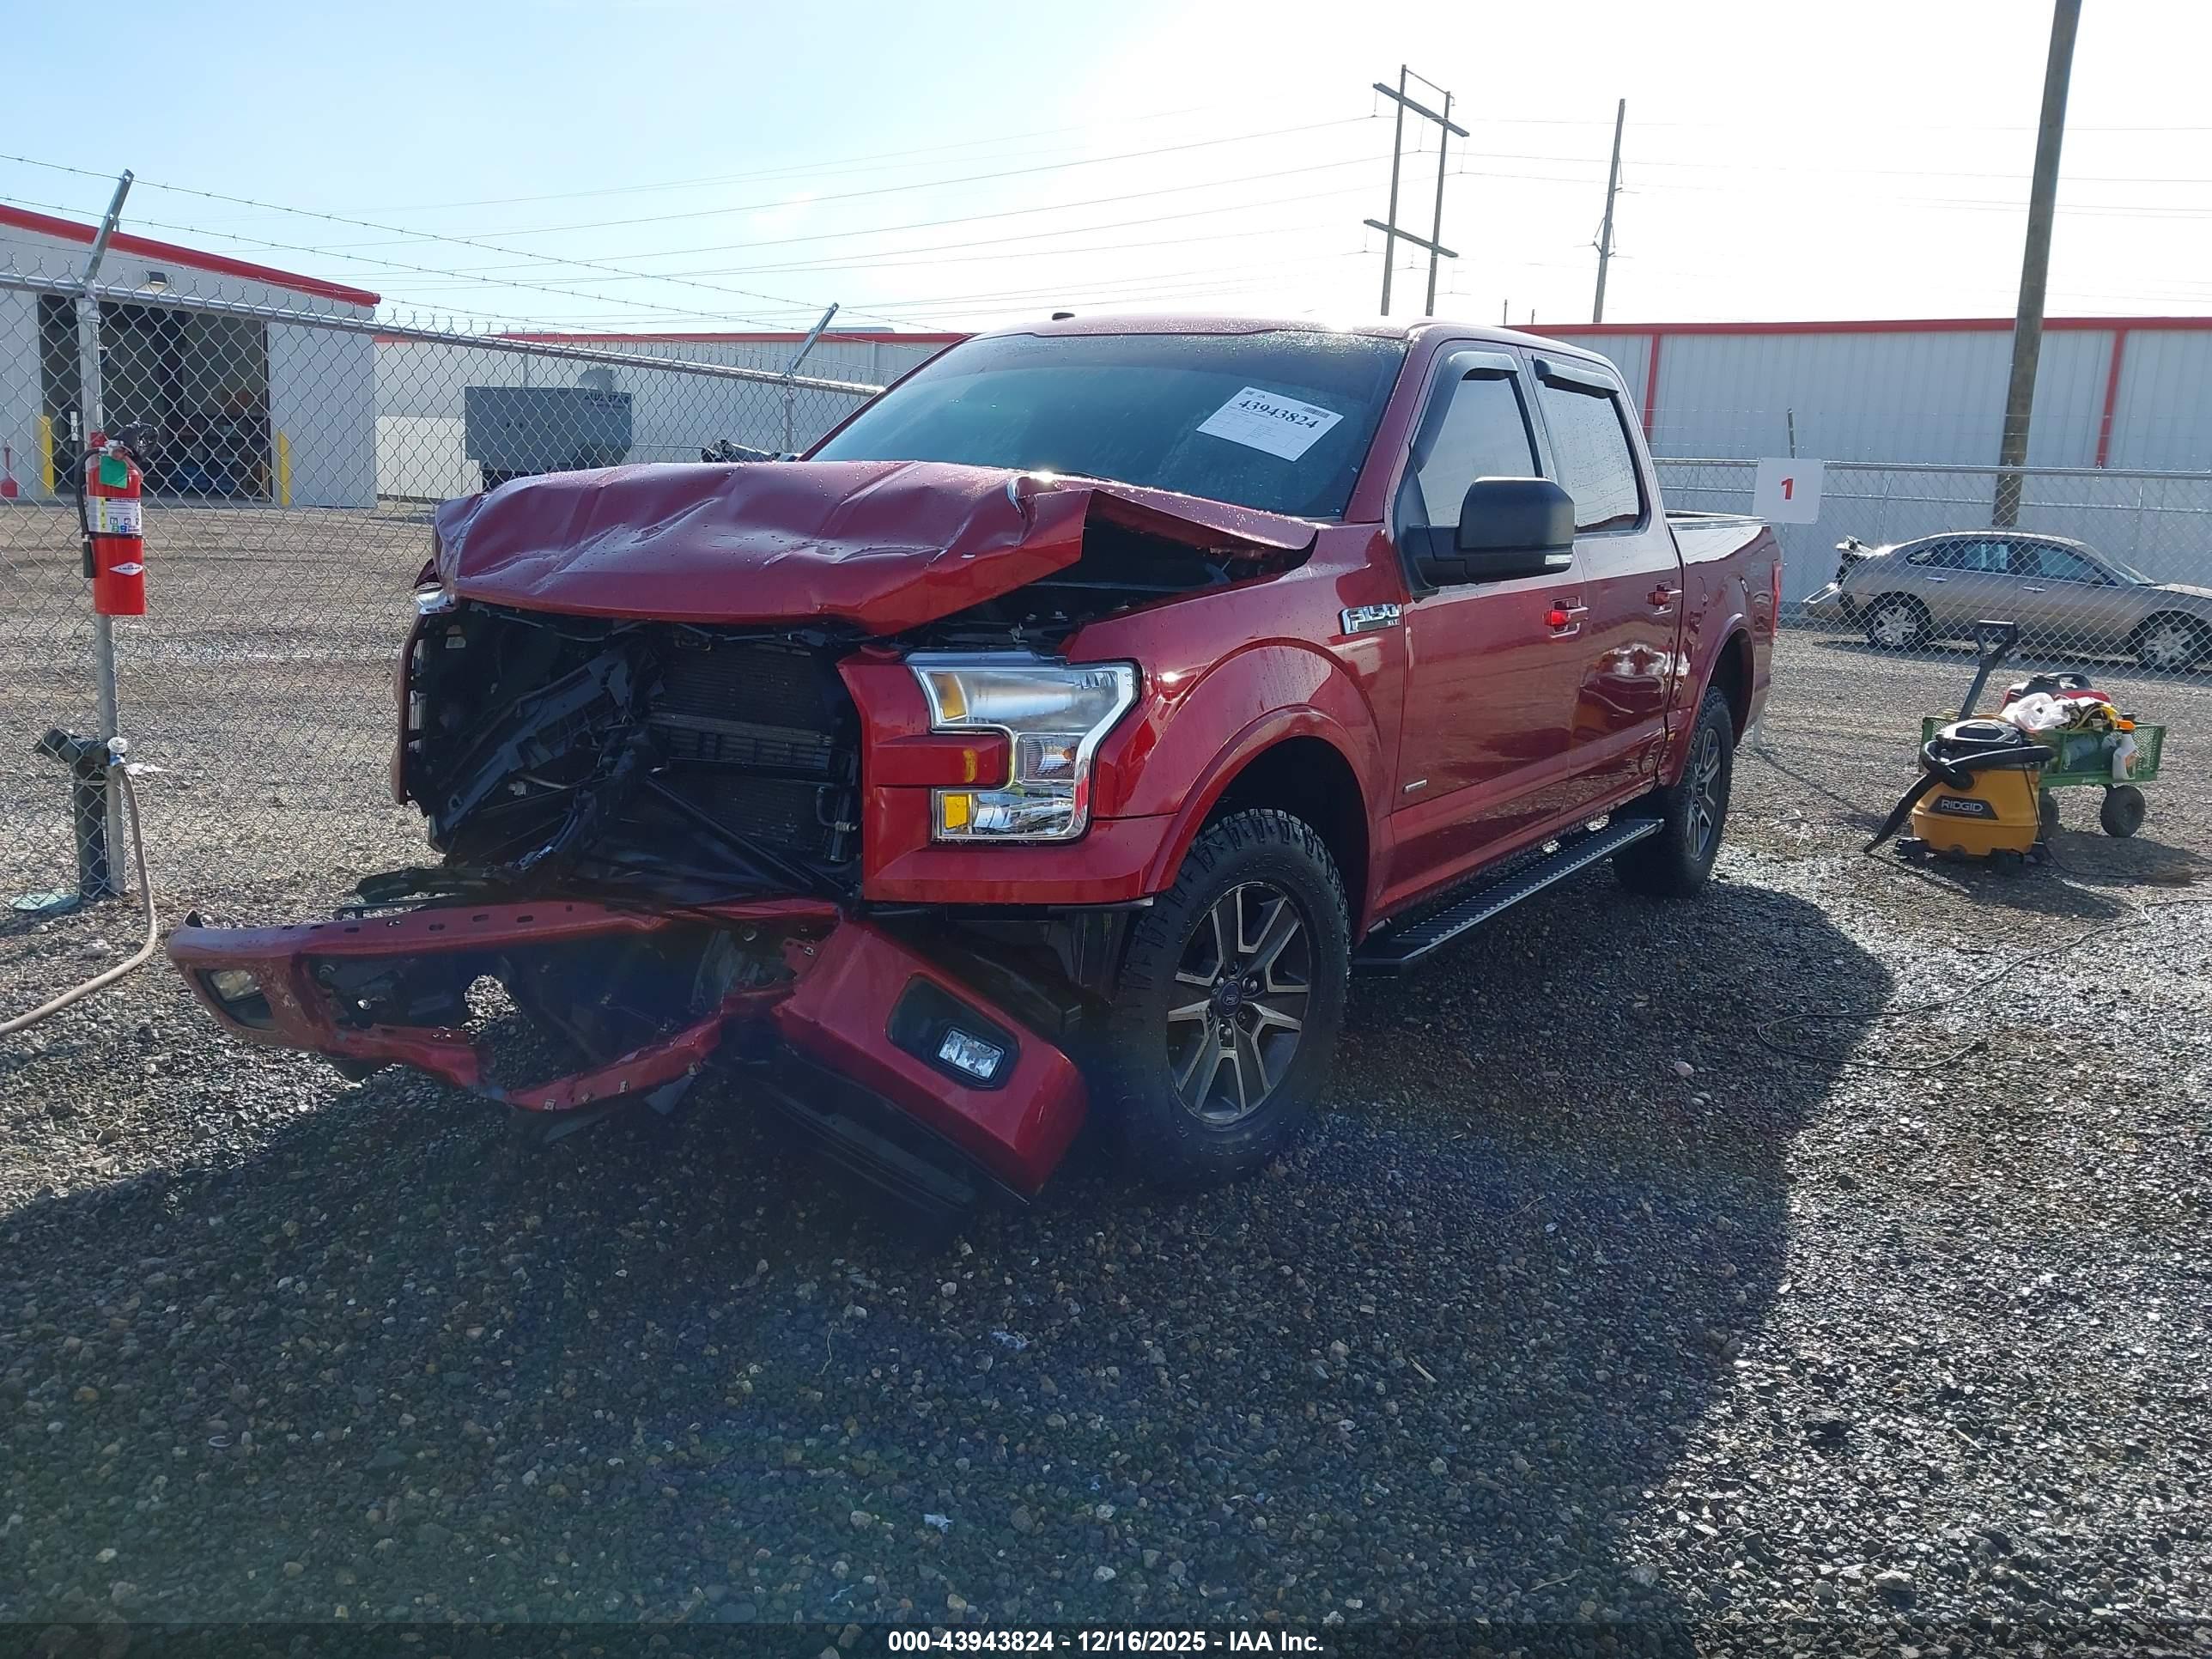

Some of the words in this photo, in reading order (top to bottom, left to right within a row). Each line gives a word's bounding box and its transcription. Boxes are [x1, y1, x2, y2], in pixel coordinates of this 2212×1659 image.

[1238, 399, 1320, 428] 43943824
[1781, 477, 1794, 500] 1
[1942, 799, 1984, 811] RIDGID
